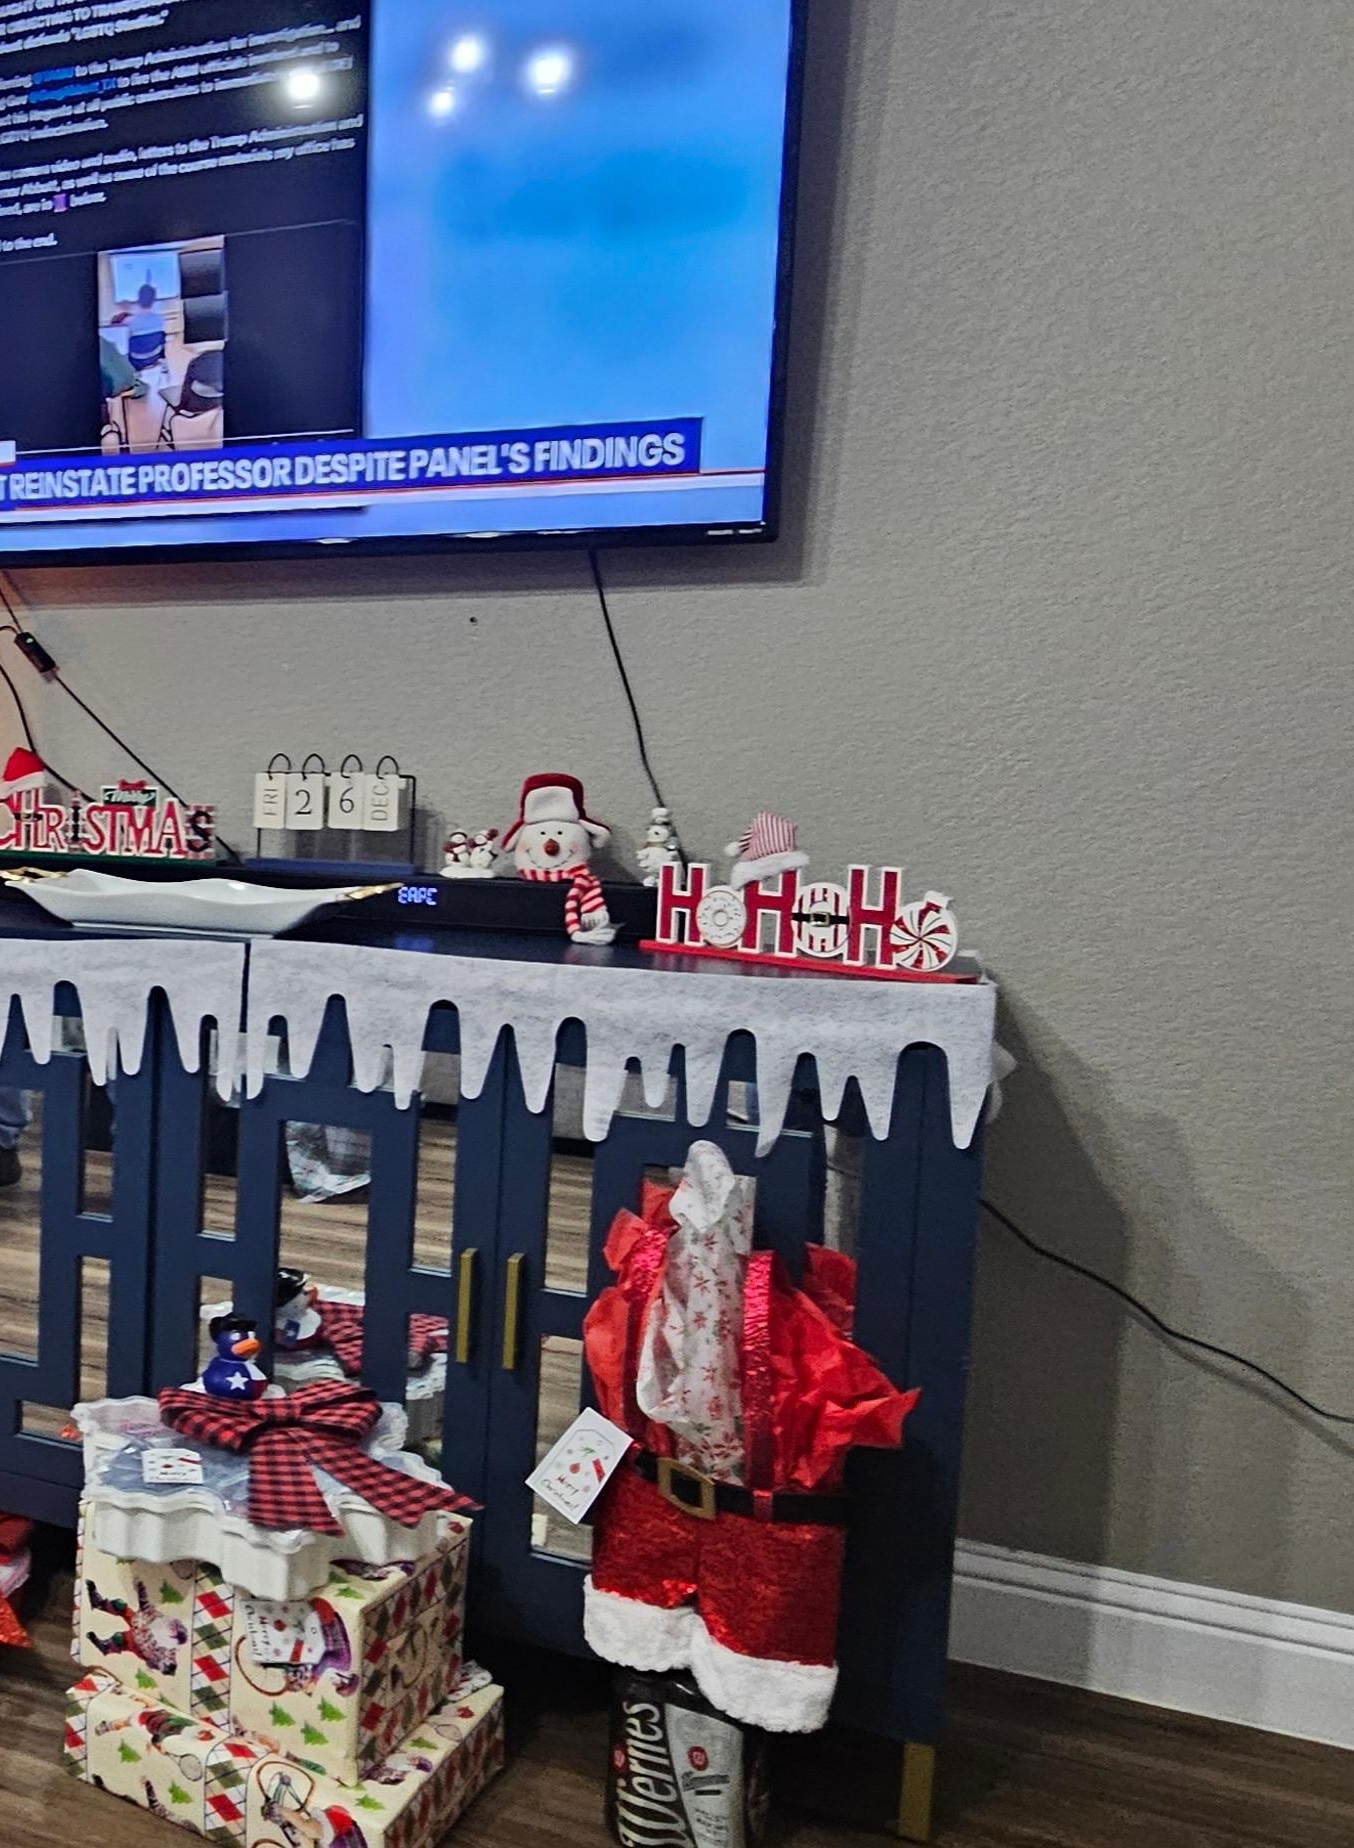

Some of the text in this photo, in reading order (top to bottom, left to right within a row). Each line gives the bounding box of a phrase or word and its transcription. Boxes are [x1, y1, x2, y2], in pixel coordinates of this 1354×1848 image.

[9, 466, 137, 500] REINSTATE
[138, 457, 293, 494] PROFESSOR
[294, 449, 407, 487] DESPITE
[409, 441, 531, 480] PANEL'S
[533, 431, 687, 473] FINDINGS
[294, 788, 313, 816] 2
[338, 786, 356, 814] 6
[370, 782, 391, 822] DEC
